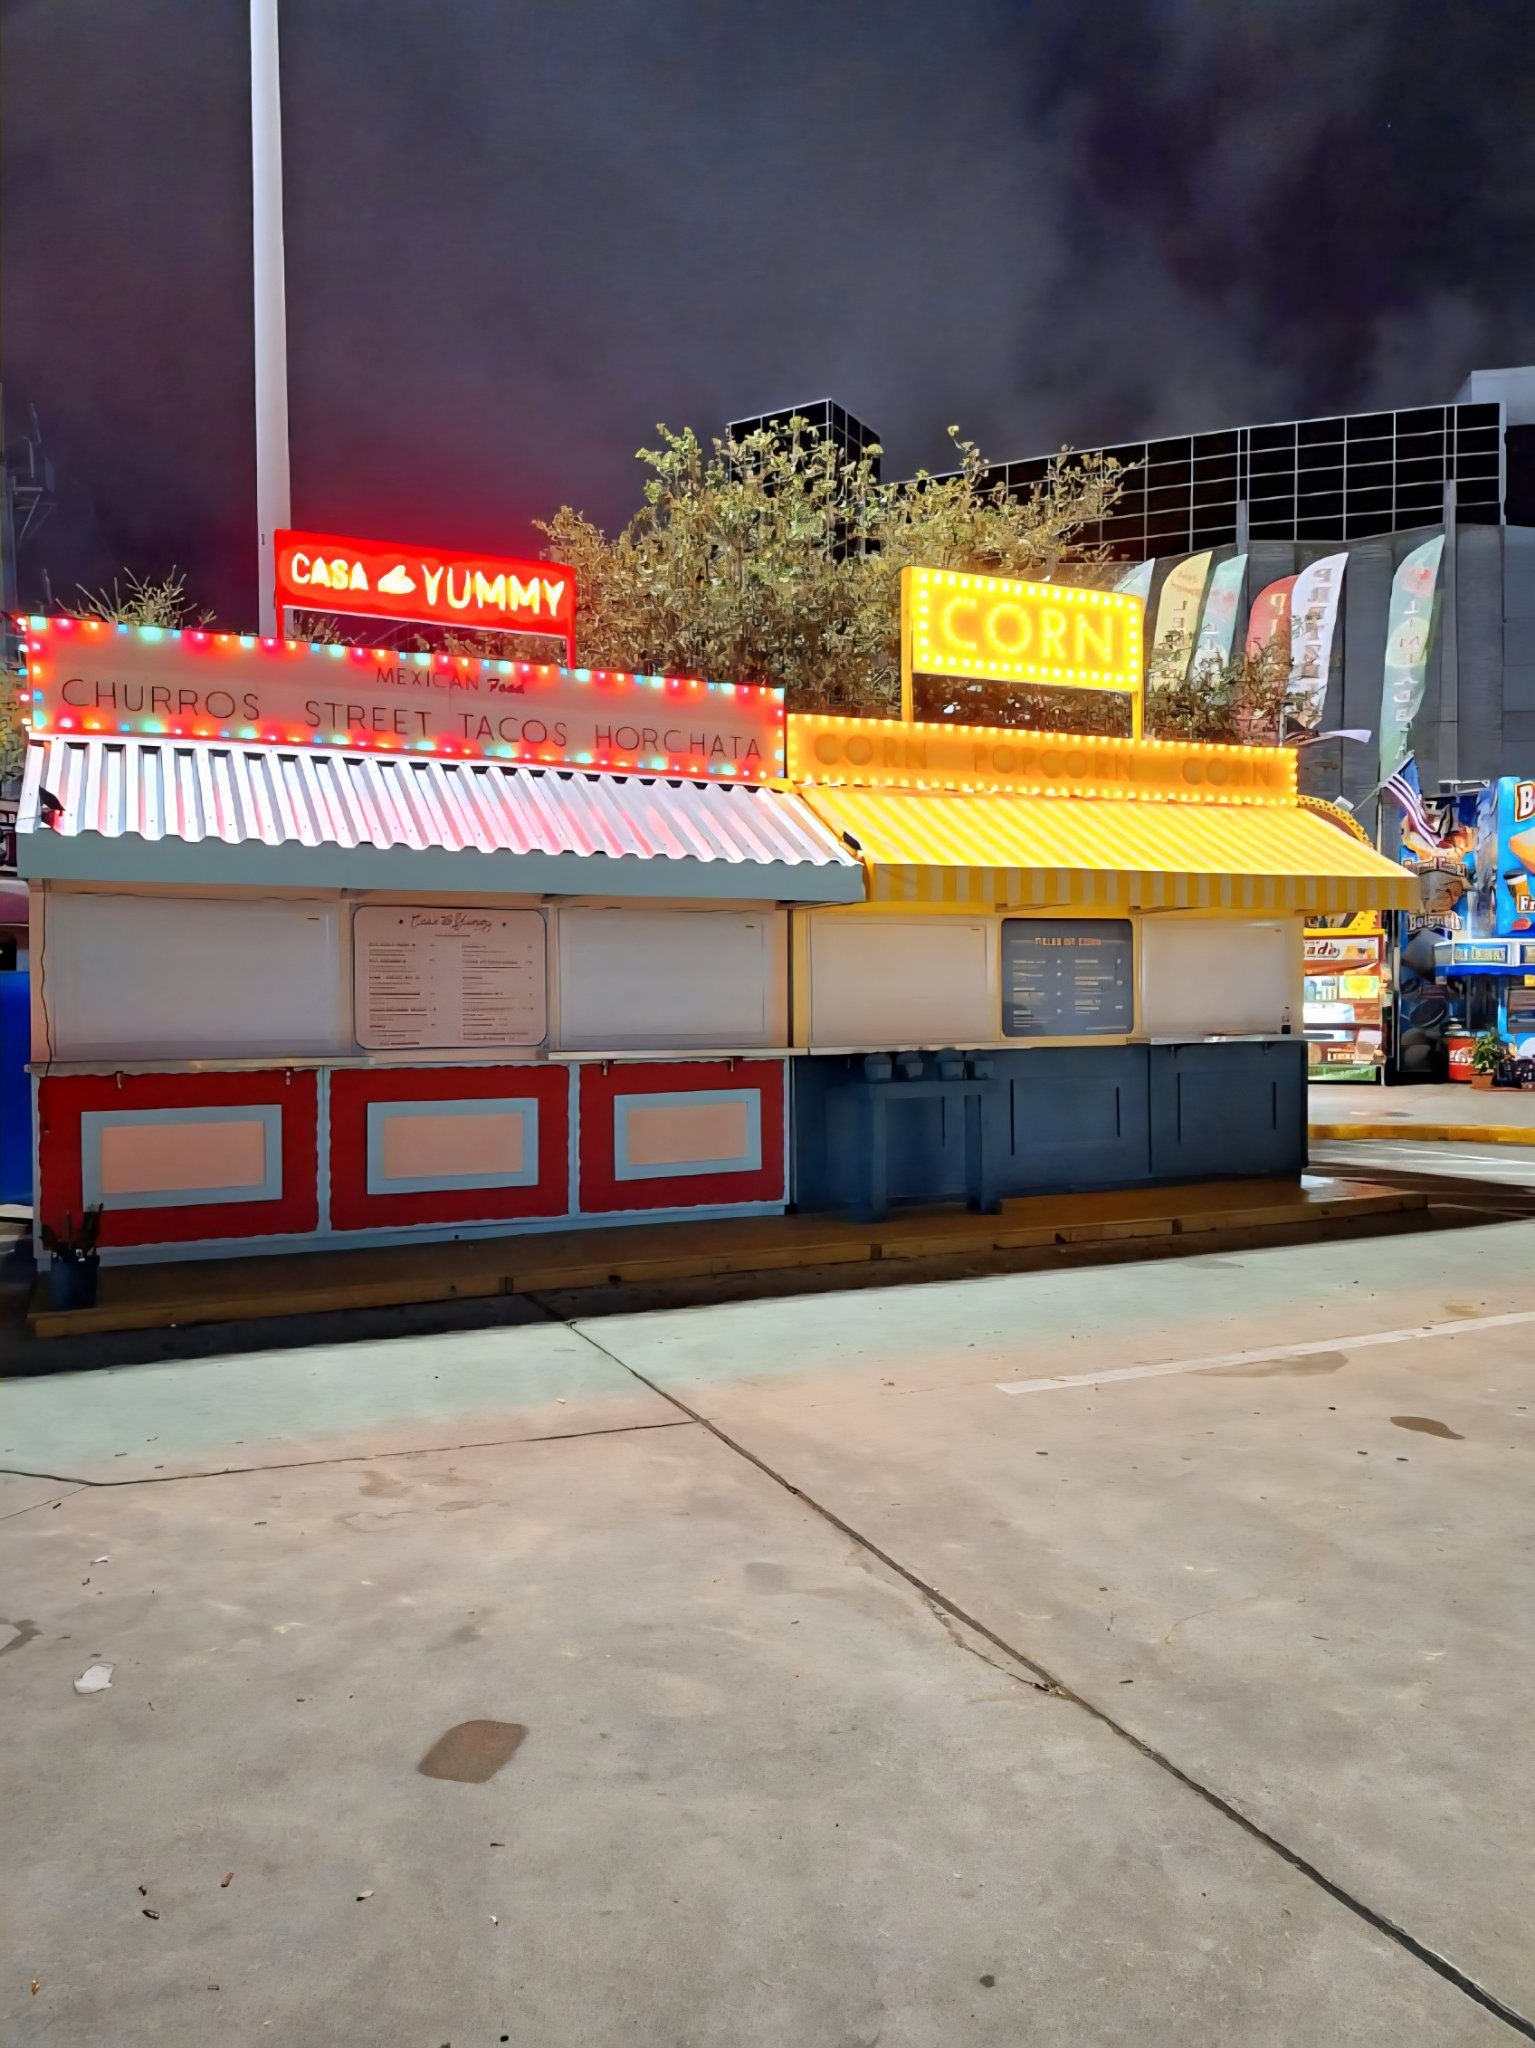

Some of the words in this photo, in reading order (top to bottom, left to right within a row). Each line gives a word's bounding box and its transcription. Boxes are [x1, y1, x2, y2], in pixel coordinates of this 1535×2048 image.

[290, 552, 369, 591] CASA
[421, 564, 566, 617] YUMMY
[940, 597, 1113, 664] CORN
[376, 667, 479, 691] MEXICAN
[61, 678, 260, 721] CHURROS
[305, 700, 431, 737] STREET
[457, 712, 567, 747] TACOS
[595, 724, 762, 760] HORCHATA
[813, 733, 928, 770] CORN
[972, 743, 1134, 782] POPCORN
[1182, 756, 1270, 787] CORN
